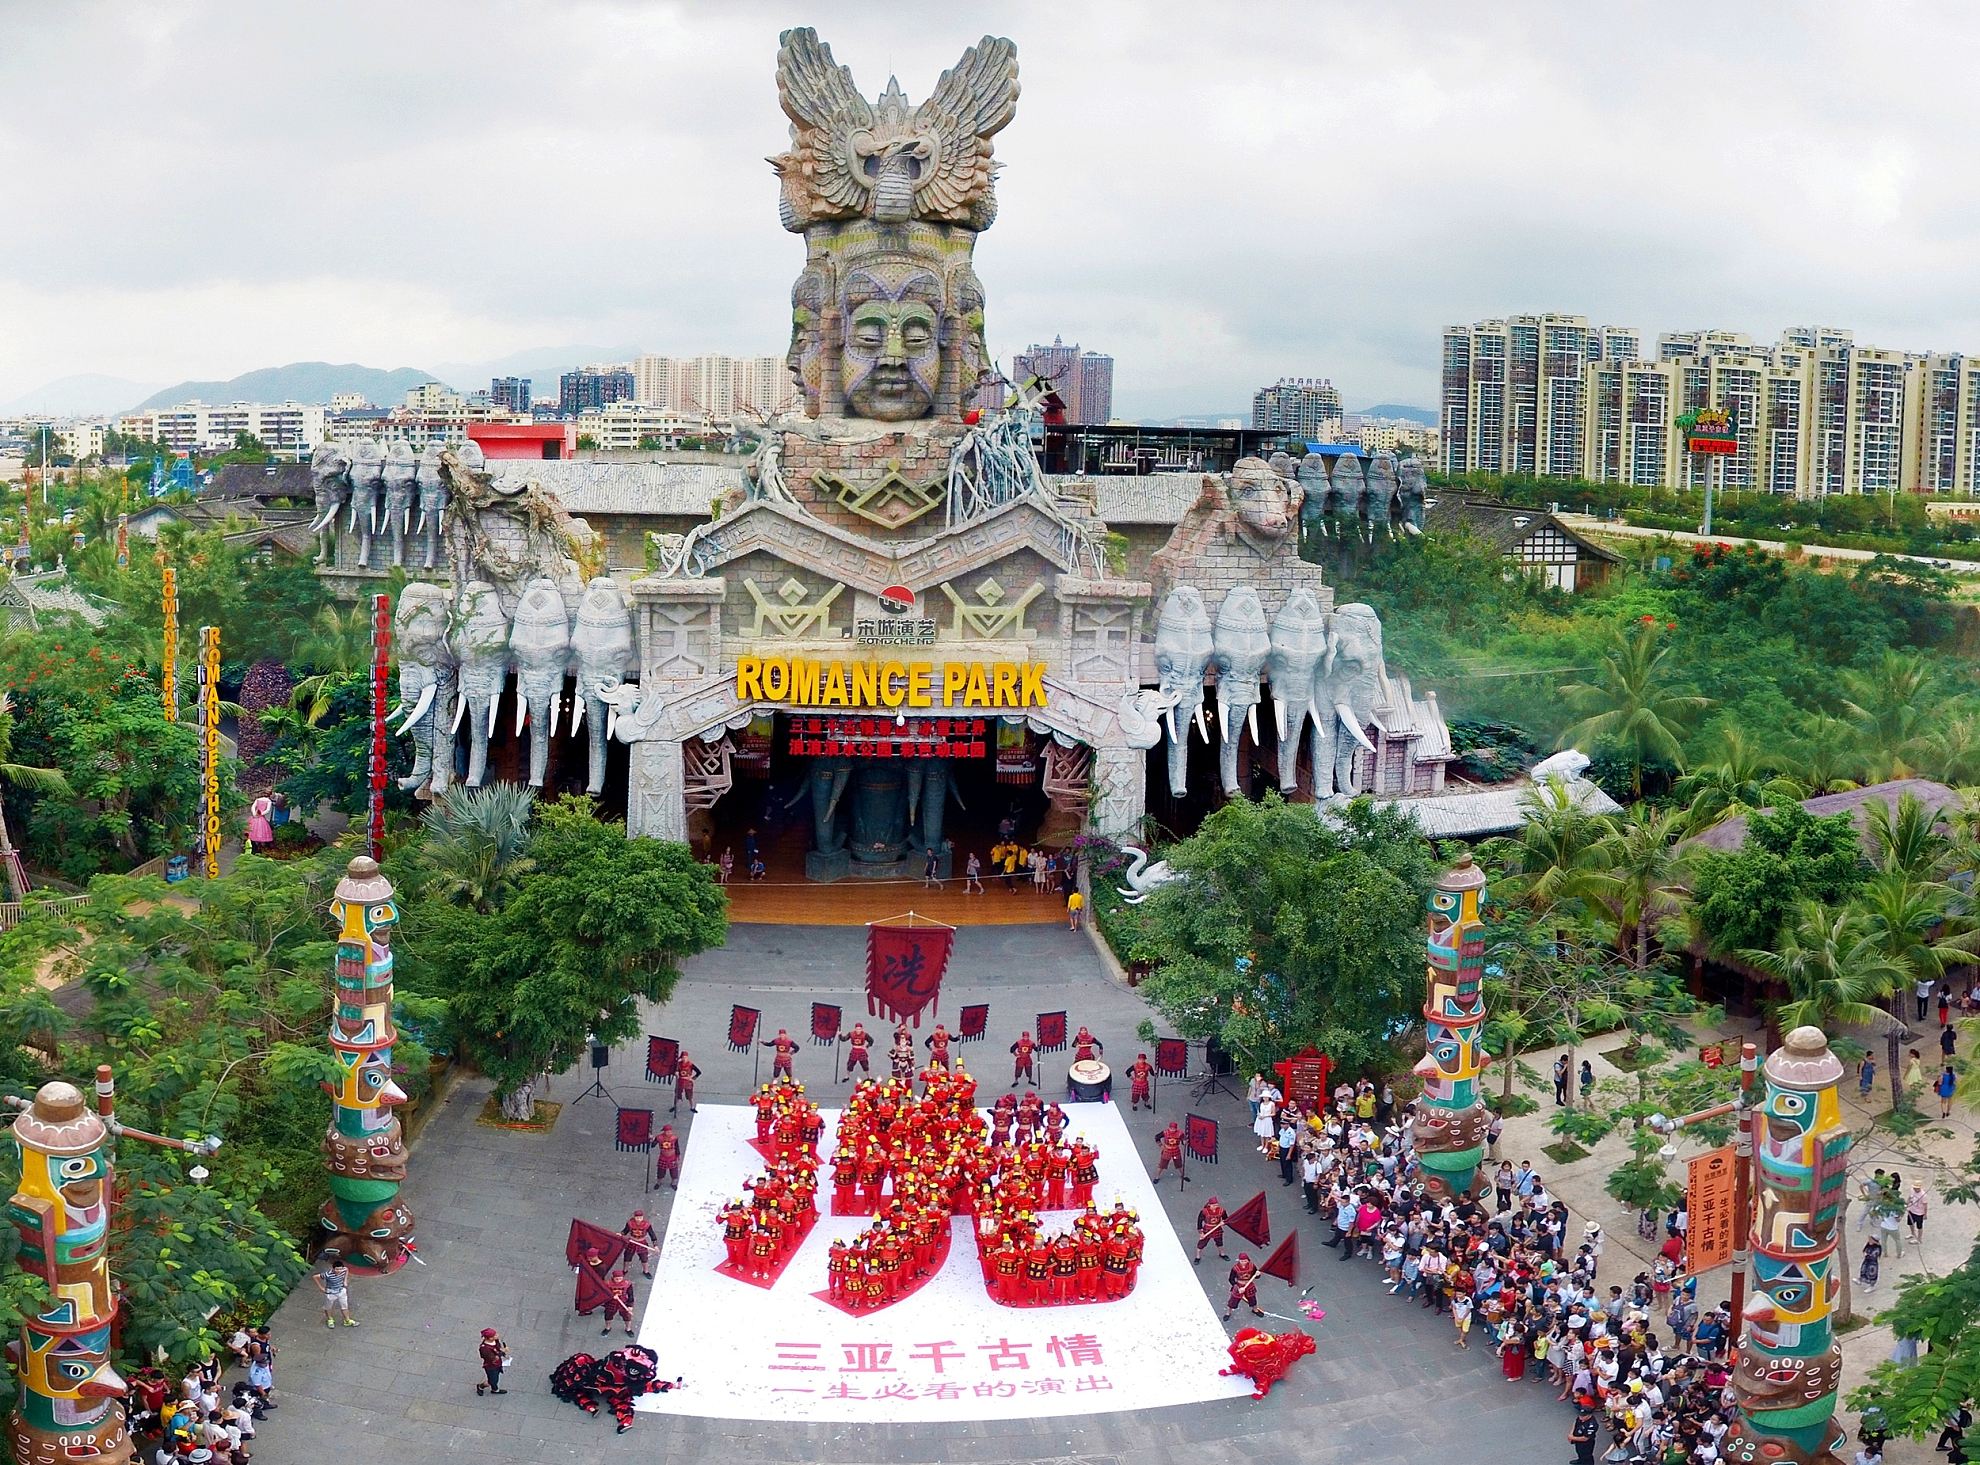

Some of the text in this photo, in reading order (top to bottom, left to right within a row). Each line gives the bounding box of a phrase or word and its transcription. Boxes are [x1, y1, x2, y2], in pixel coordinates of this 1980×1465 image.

[162, 569, 176, 672] ROMANCE
[858, 619, 936, 636] 宋城演艺
[375, 595, 391, 718] ROMANCE
[735, 656, 1049, 707] ROMANCE PARK
[205, 627, 221, 767] ROMANCE
[918, 718, 986, 737] 冰雪世界
[372, 721, 388, 791] SHOW
[900, 741, 986, 758] 彩色动物园
[205, 775, 222, 854] SHOW
[1702, 1184, 1715, 1252] 三亚千古情
[1718, 1188, 1730, 1261] 一生必看的演出
[768, 1333, 1104, 1374] 三亚千古情
[771, 1374, 1114, 1402] 一生必看的演出
